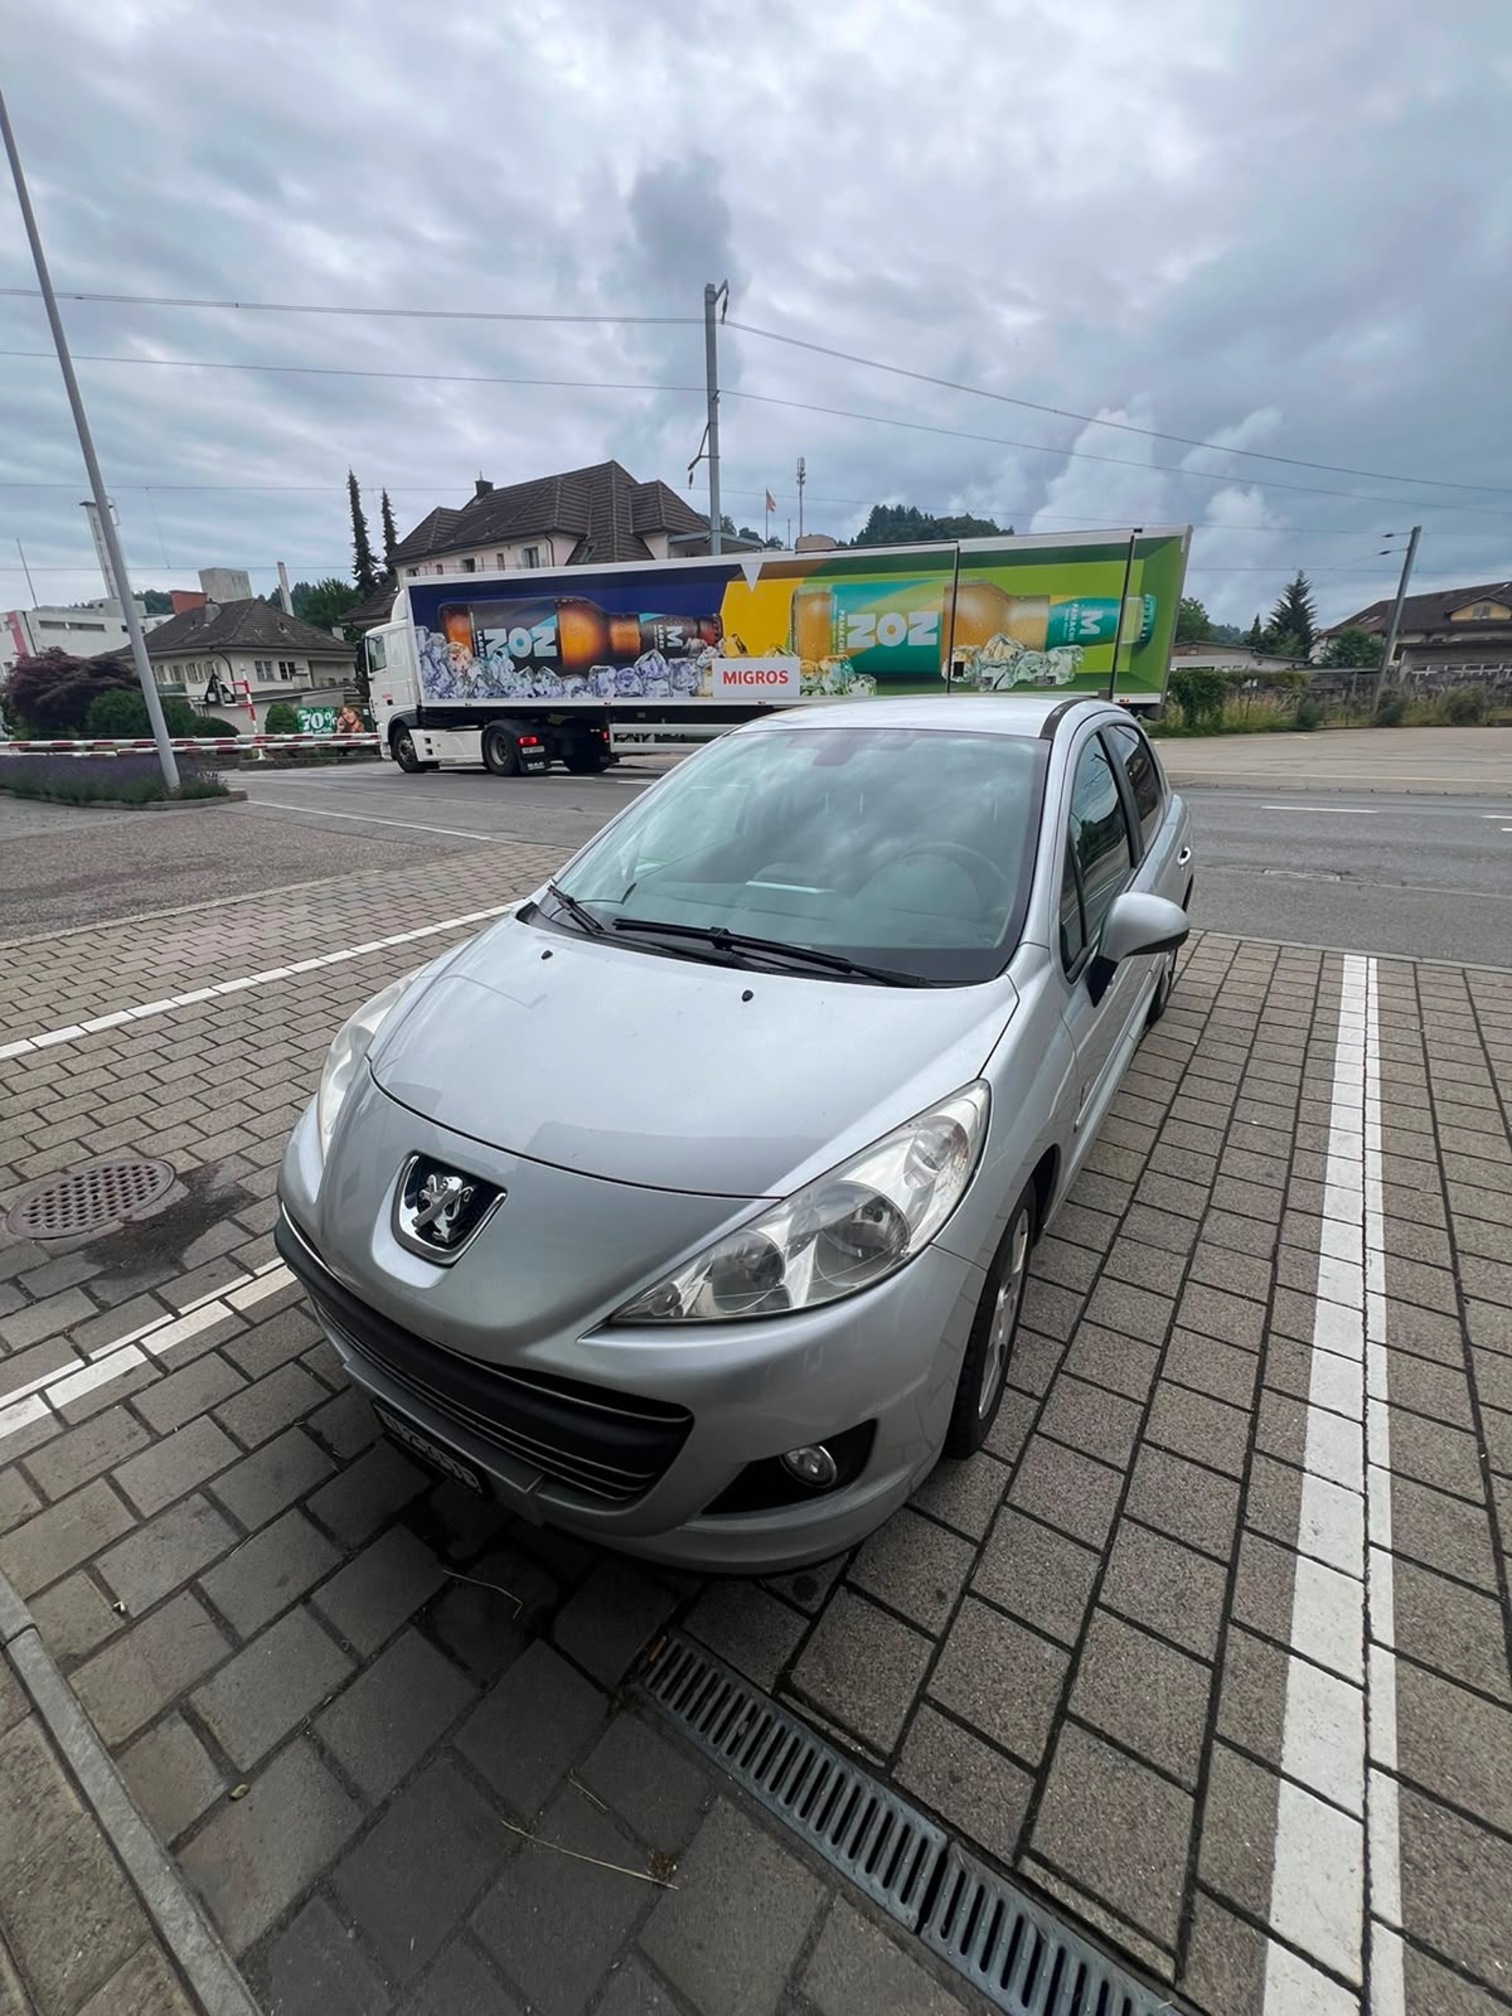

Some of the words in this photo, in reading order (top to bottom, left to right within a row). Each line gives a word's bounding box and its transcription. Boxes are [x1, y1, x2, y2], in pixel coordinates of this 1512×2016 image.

[1080, 610, 1103, 634] M
[666, 626, 683, 648] M
[723, 670, 788, 684] MIGROS
[301, 709, 337, 731] 70%
